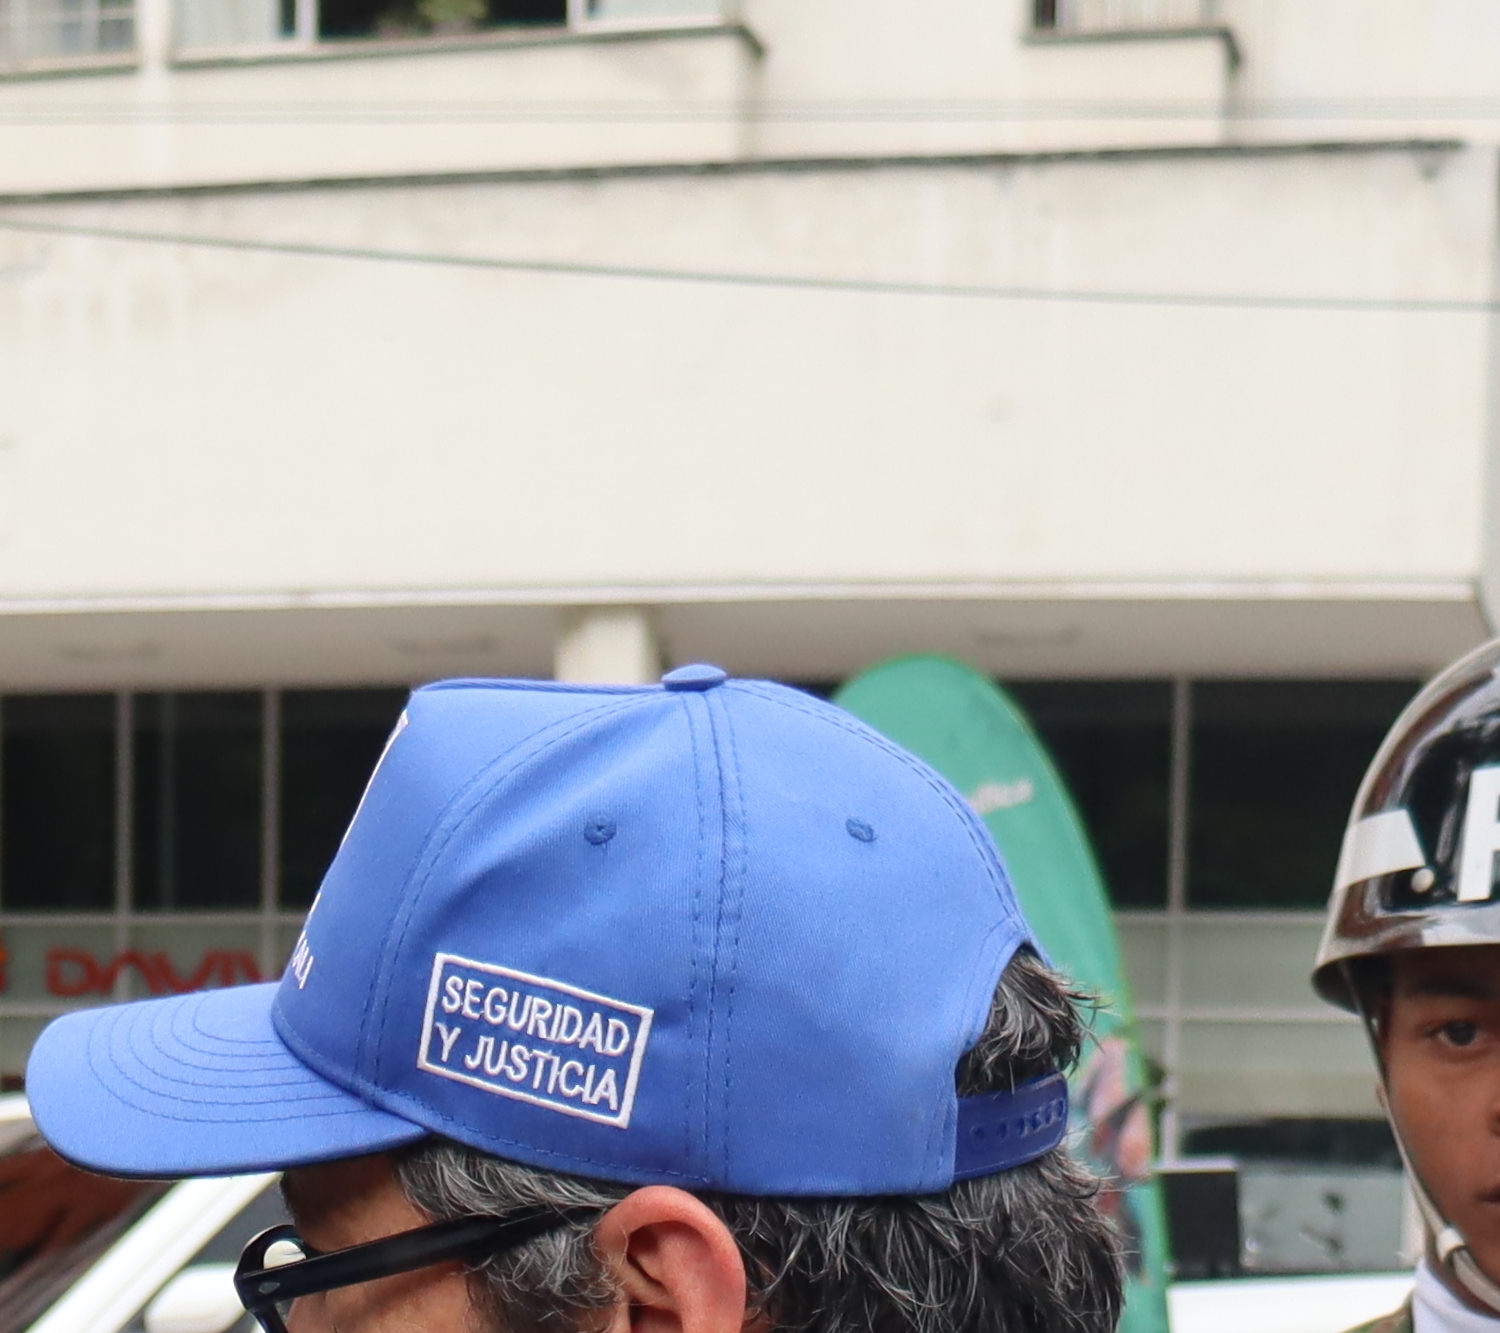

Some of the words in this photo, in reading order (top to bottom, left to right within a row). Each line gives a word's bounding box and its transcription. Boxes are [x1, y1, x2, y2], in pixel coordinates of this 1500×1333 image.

[441, 975, 631, 1057] SEGURIDAD
[435, 1022, 462, 1062] Y
[464, 1034, 619, 1111] JUSTICIA
